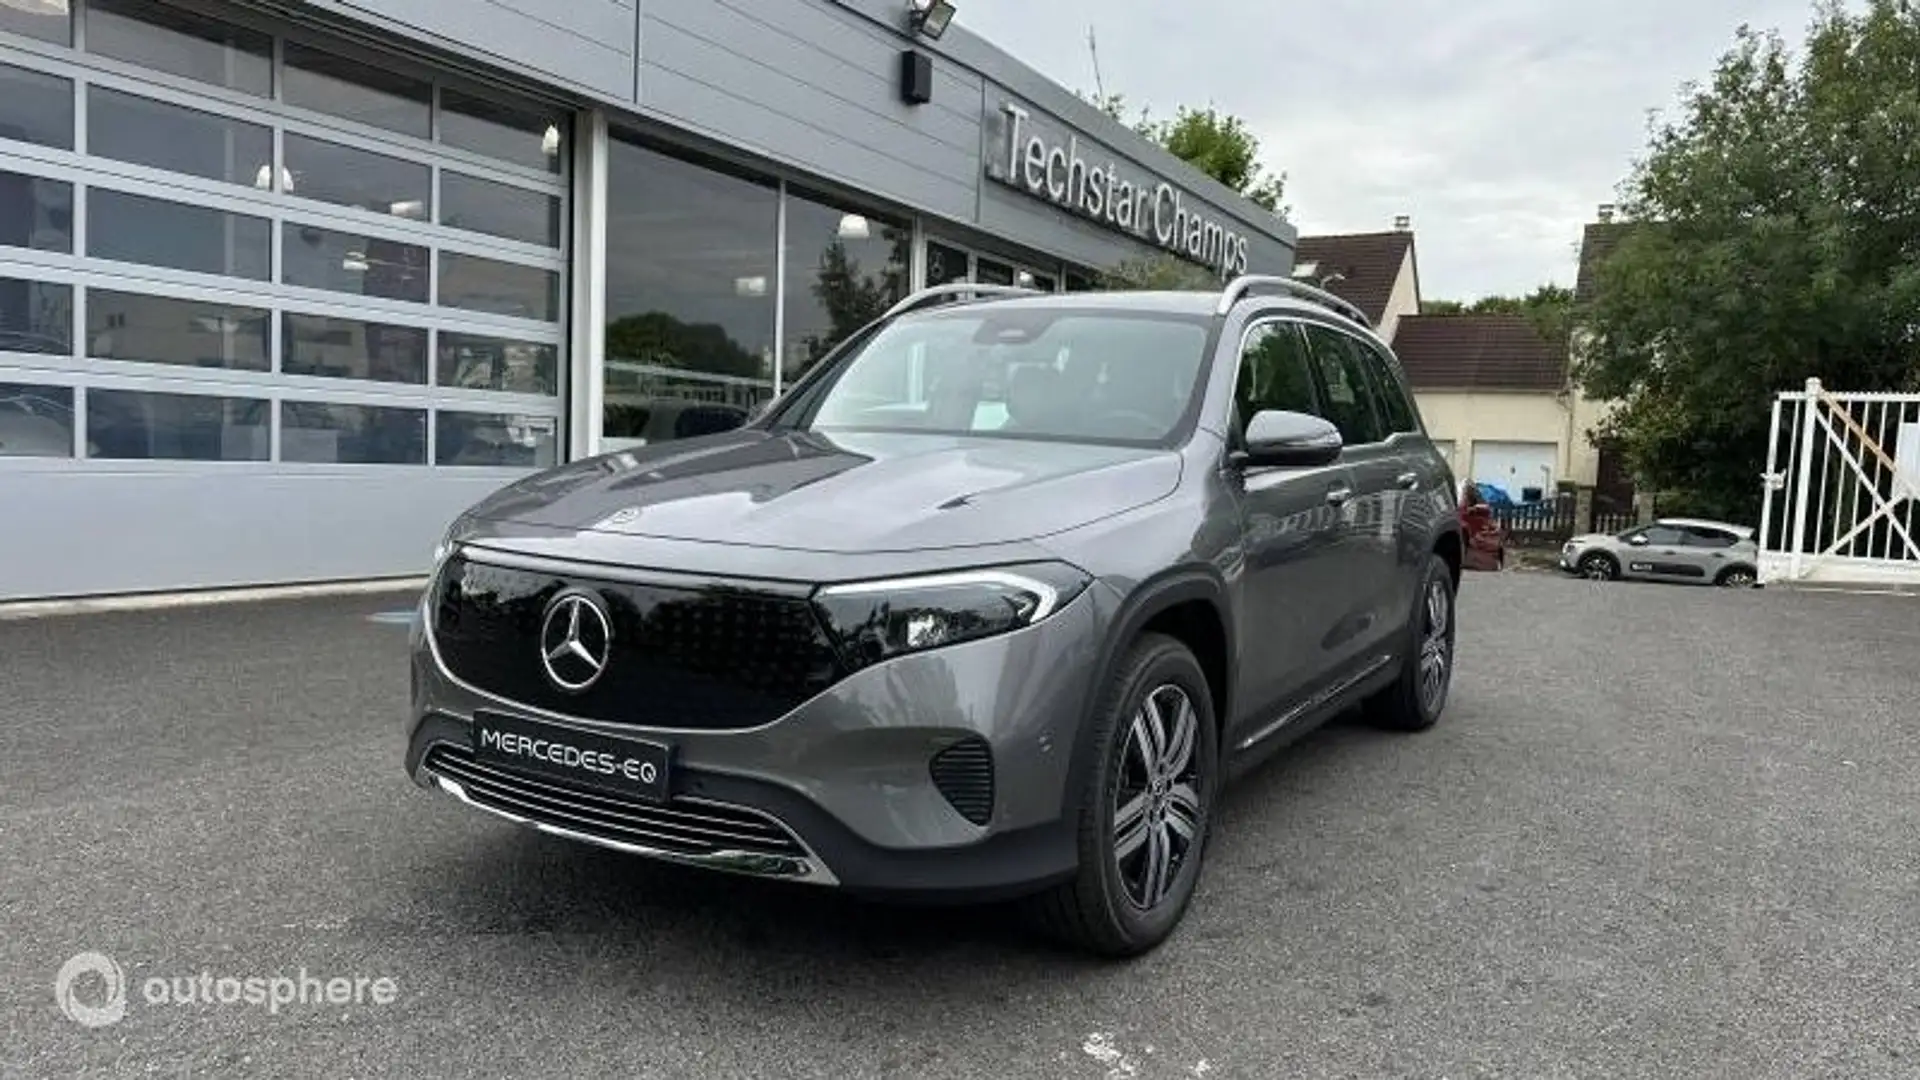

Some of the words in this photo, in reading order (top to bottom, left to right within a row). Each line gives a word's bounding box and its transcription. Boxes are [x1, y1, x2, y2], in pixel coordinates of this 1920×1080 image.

[1002, 103, 1147, 235] Techstar
[1154, 182, 1247, 281] Champs
[481, 728, 656, 783] MERCEDES-EQ
